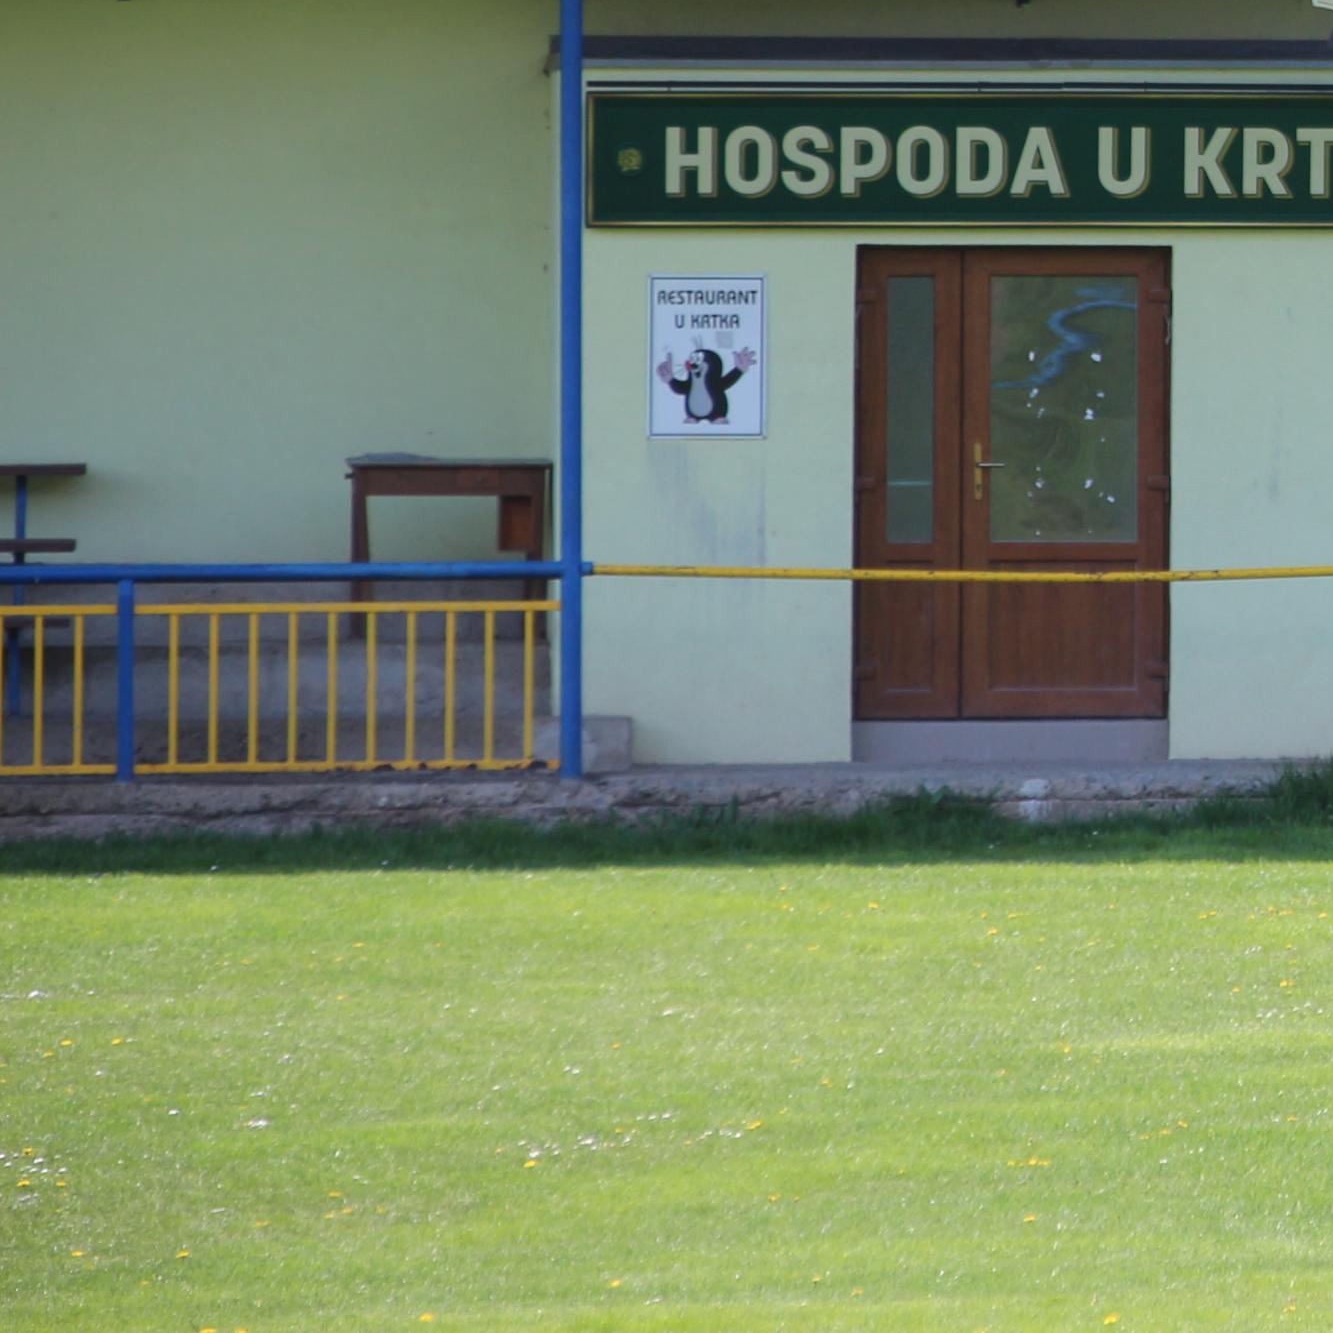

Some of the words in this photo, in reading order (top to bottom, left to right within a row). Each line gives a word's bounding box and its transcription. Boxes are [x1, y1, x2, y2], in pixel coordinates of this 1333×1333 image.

[664, 125, 1071, 198] HOSPODA
[1097, 126, 1153, 199] U
[656, 289, 758, 305] RESTAURANT
[674, 314, 685, 329] U
[690, 314, 740, 329] KRTKA
